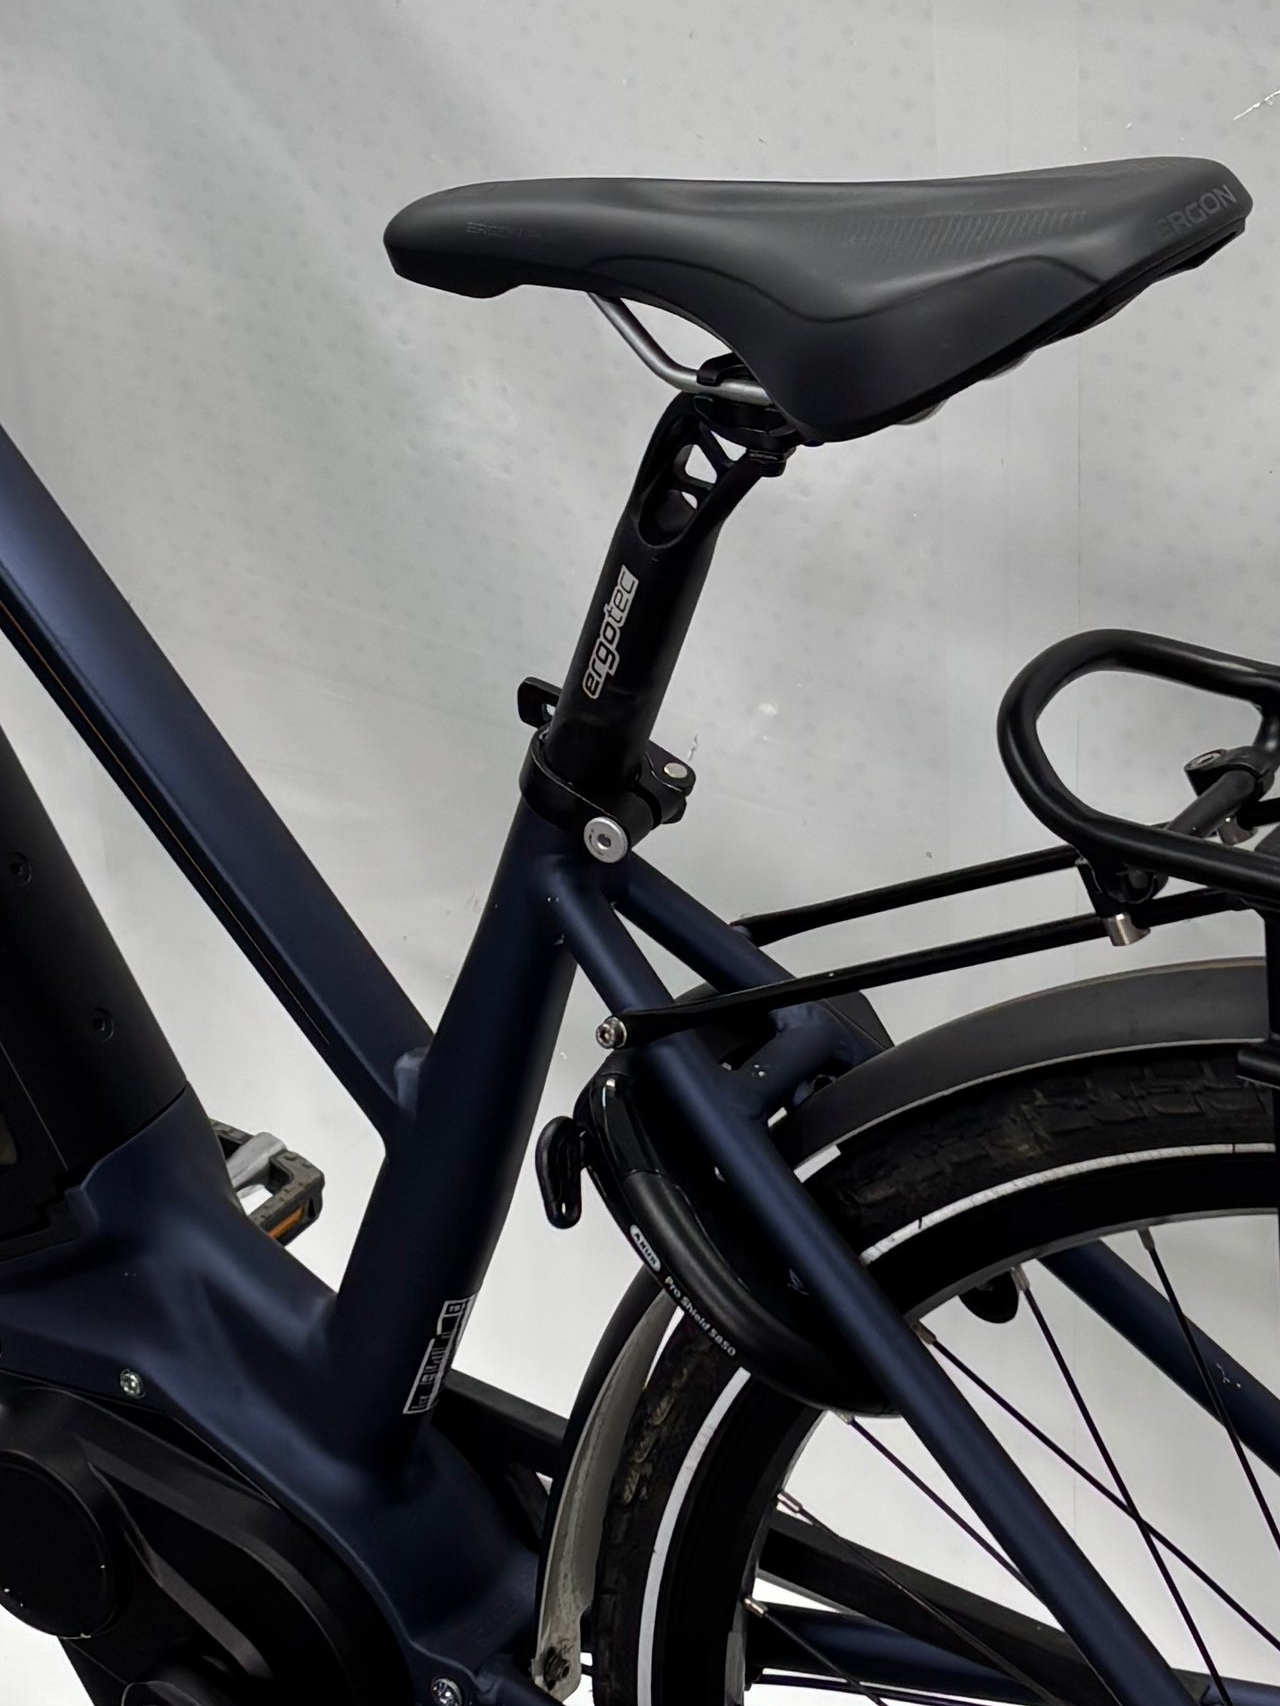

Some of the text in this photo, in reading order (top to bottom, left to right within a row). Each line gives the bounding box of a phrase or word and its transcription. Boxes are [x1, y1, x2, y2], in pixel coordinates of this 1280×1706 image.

[1156, 184, 1238, 241] ERGON
[583, 568, 637, 698] ergotec
[664, 1275, 682, 1299] Pro
[680, 1295, 711, 1331] Shield
